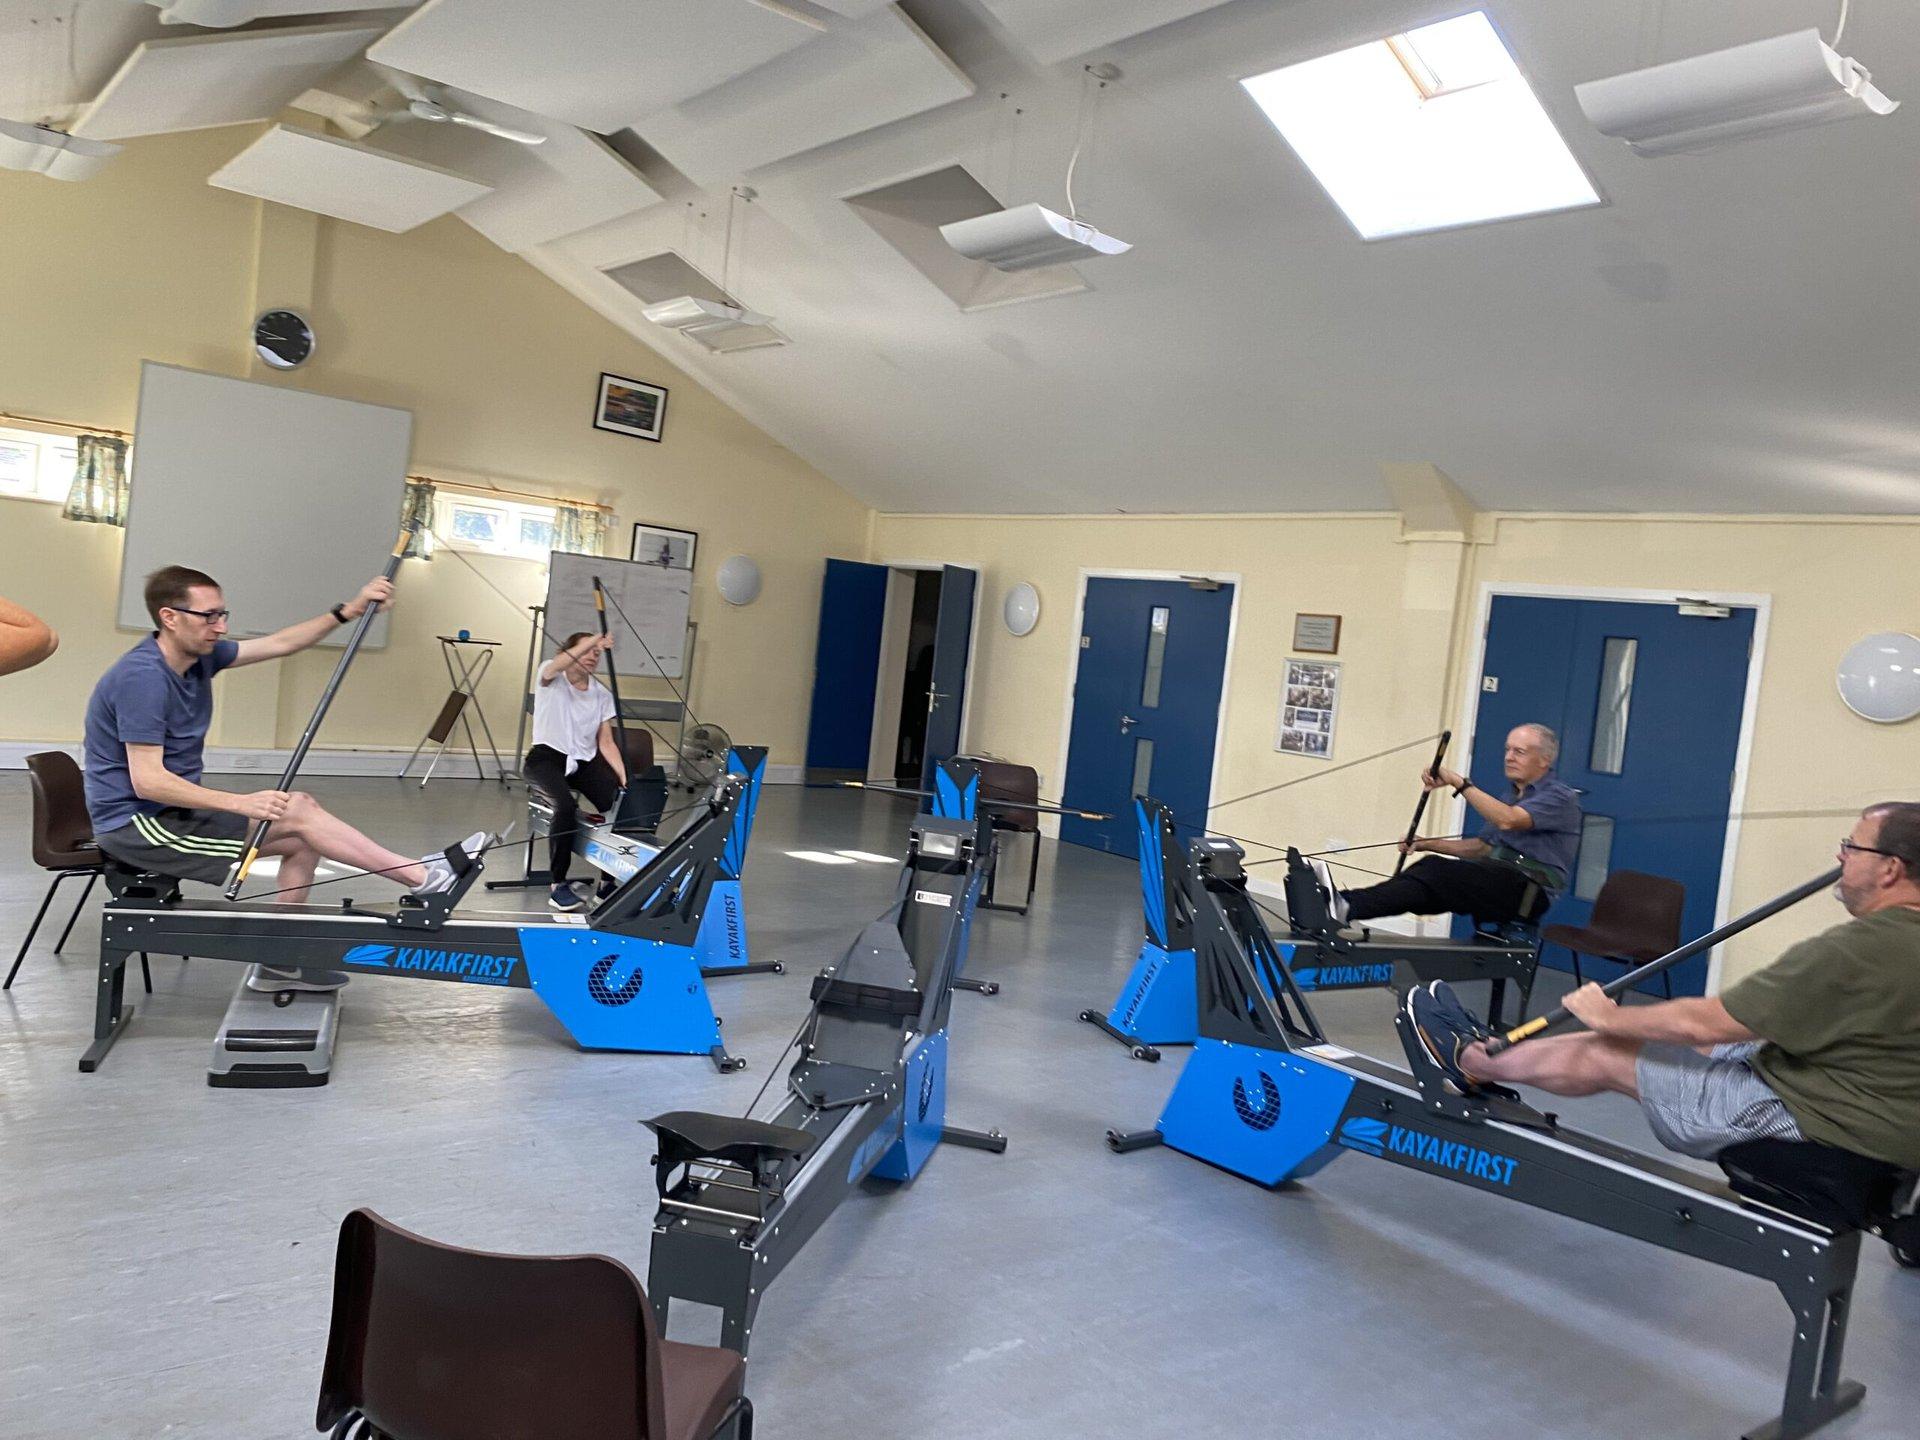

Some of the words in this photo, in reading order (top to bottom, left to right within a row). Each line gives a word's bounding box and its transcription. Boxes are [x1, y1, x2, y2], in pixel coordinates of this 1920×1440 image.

[724, 894, 739, 960] KAYAKFIRST
[394, 947, 518, 978] KAYAKFIRST
[1320, 963, 1395, 985] KAYAKFIRST
[1121, 961, 1158, 1028] KAYAKFIRST
[1388, 1125, 1519, 1186] KAYAKFIRST
